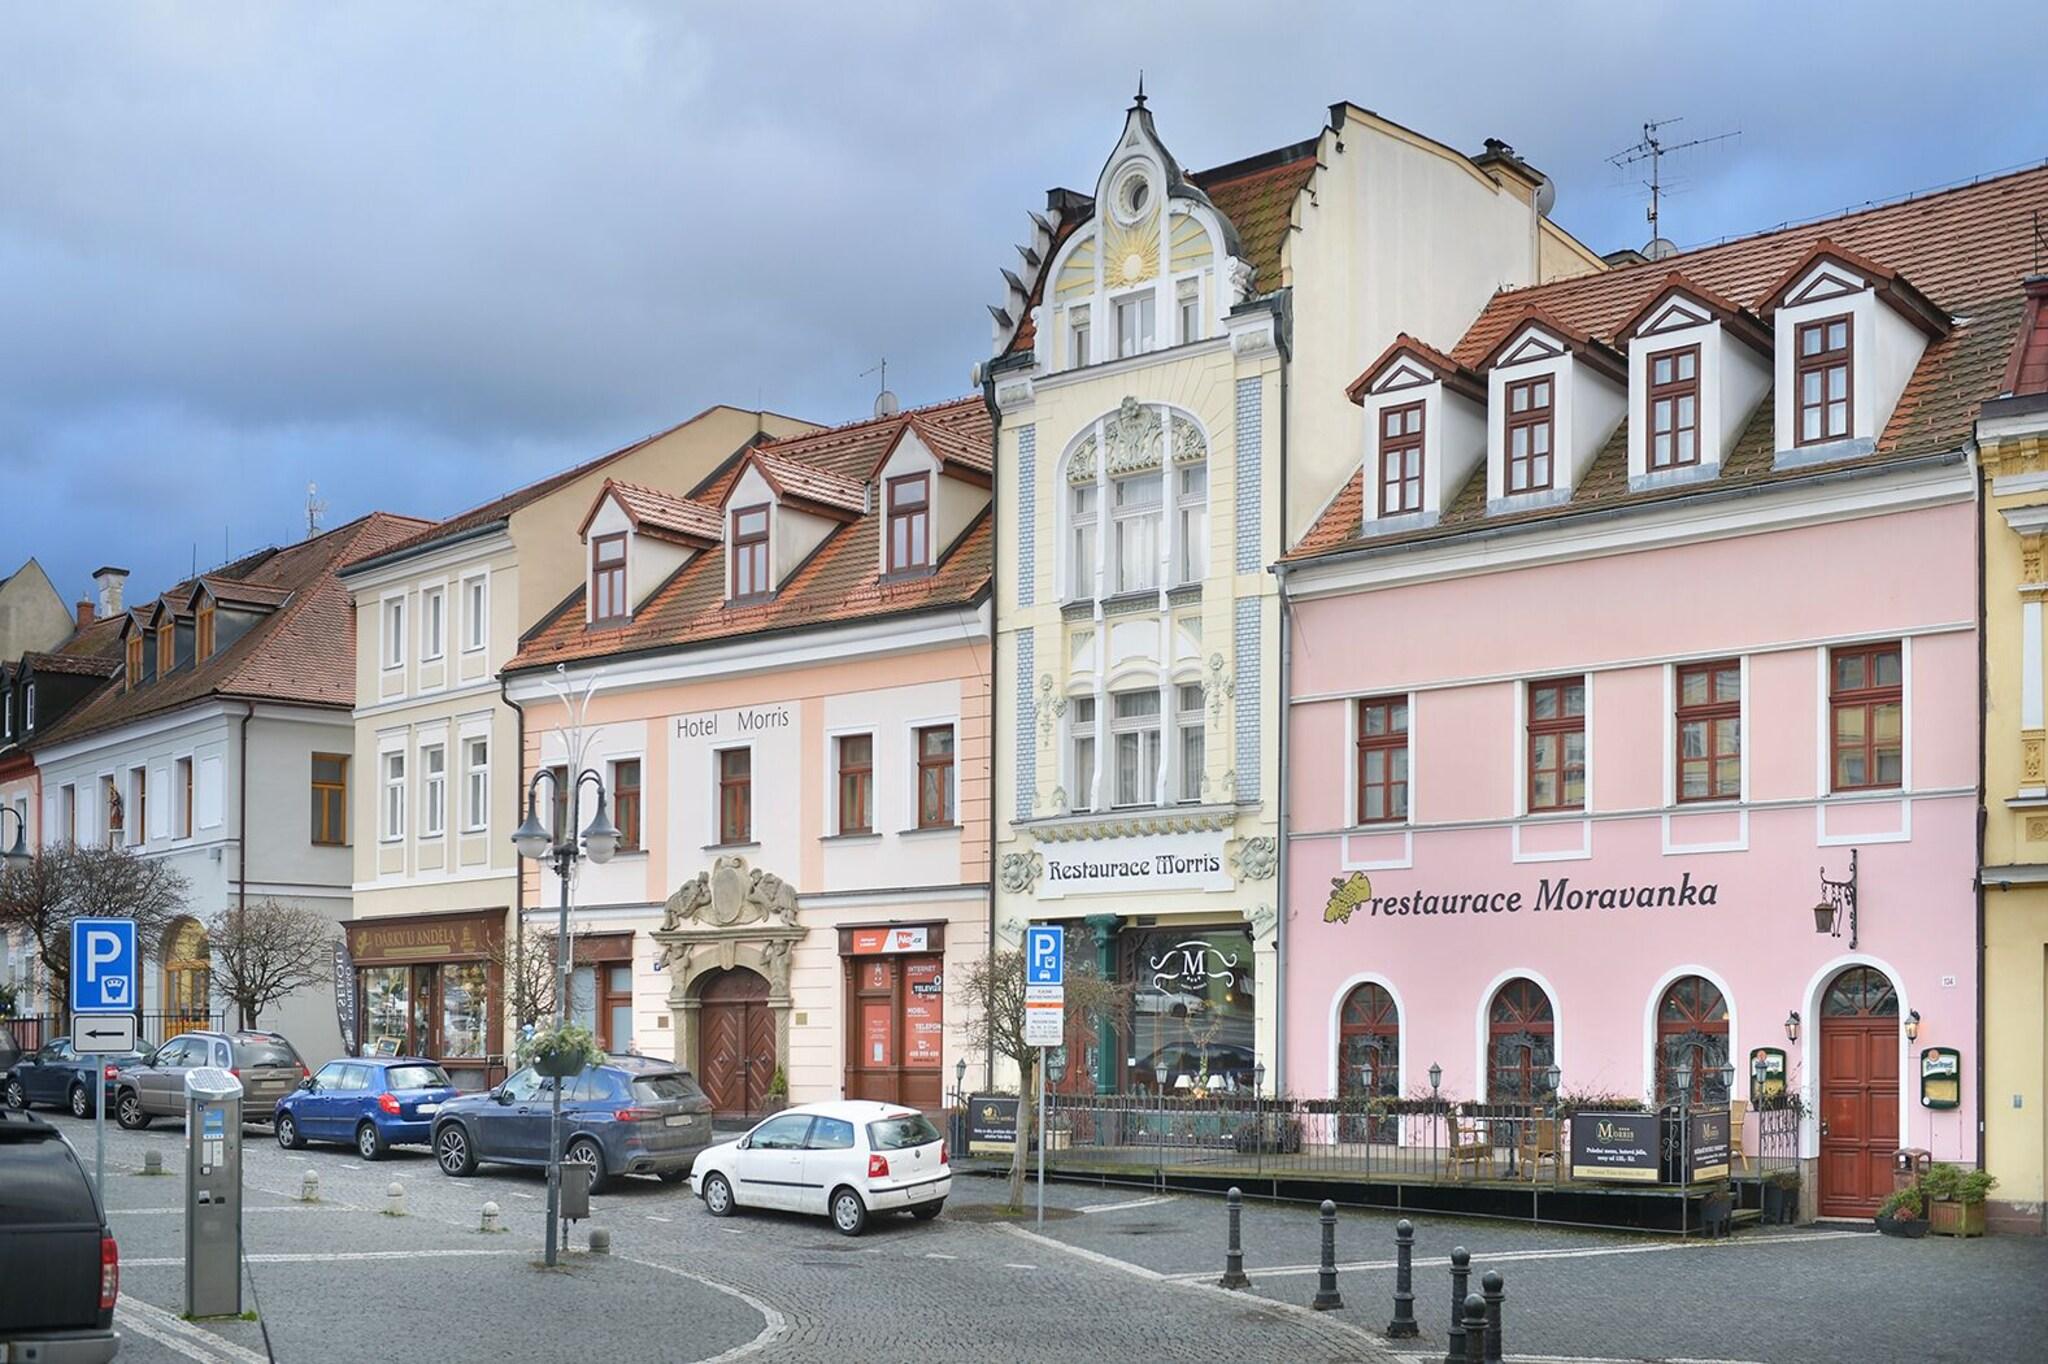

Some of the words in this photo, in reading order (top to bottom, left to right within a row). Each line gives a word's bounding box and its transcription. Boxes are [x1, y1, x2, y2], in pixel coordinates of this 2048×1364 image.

[677, 713, 718, 738] Hotel
[737, 706, 790, 731] Morris
[1048, 860, 1151, 881] Restaurace
[1155, 853, 1221, 875] Morris
[1371, 890, 1522, 916] restaurace
[1534, 872, 1718, 912] Moravanka
[87, 931, 122, 982] P
[1035, 934, 1056, 967] P
[1181, 950, 1206, 976] M
